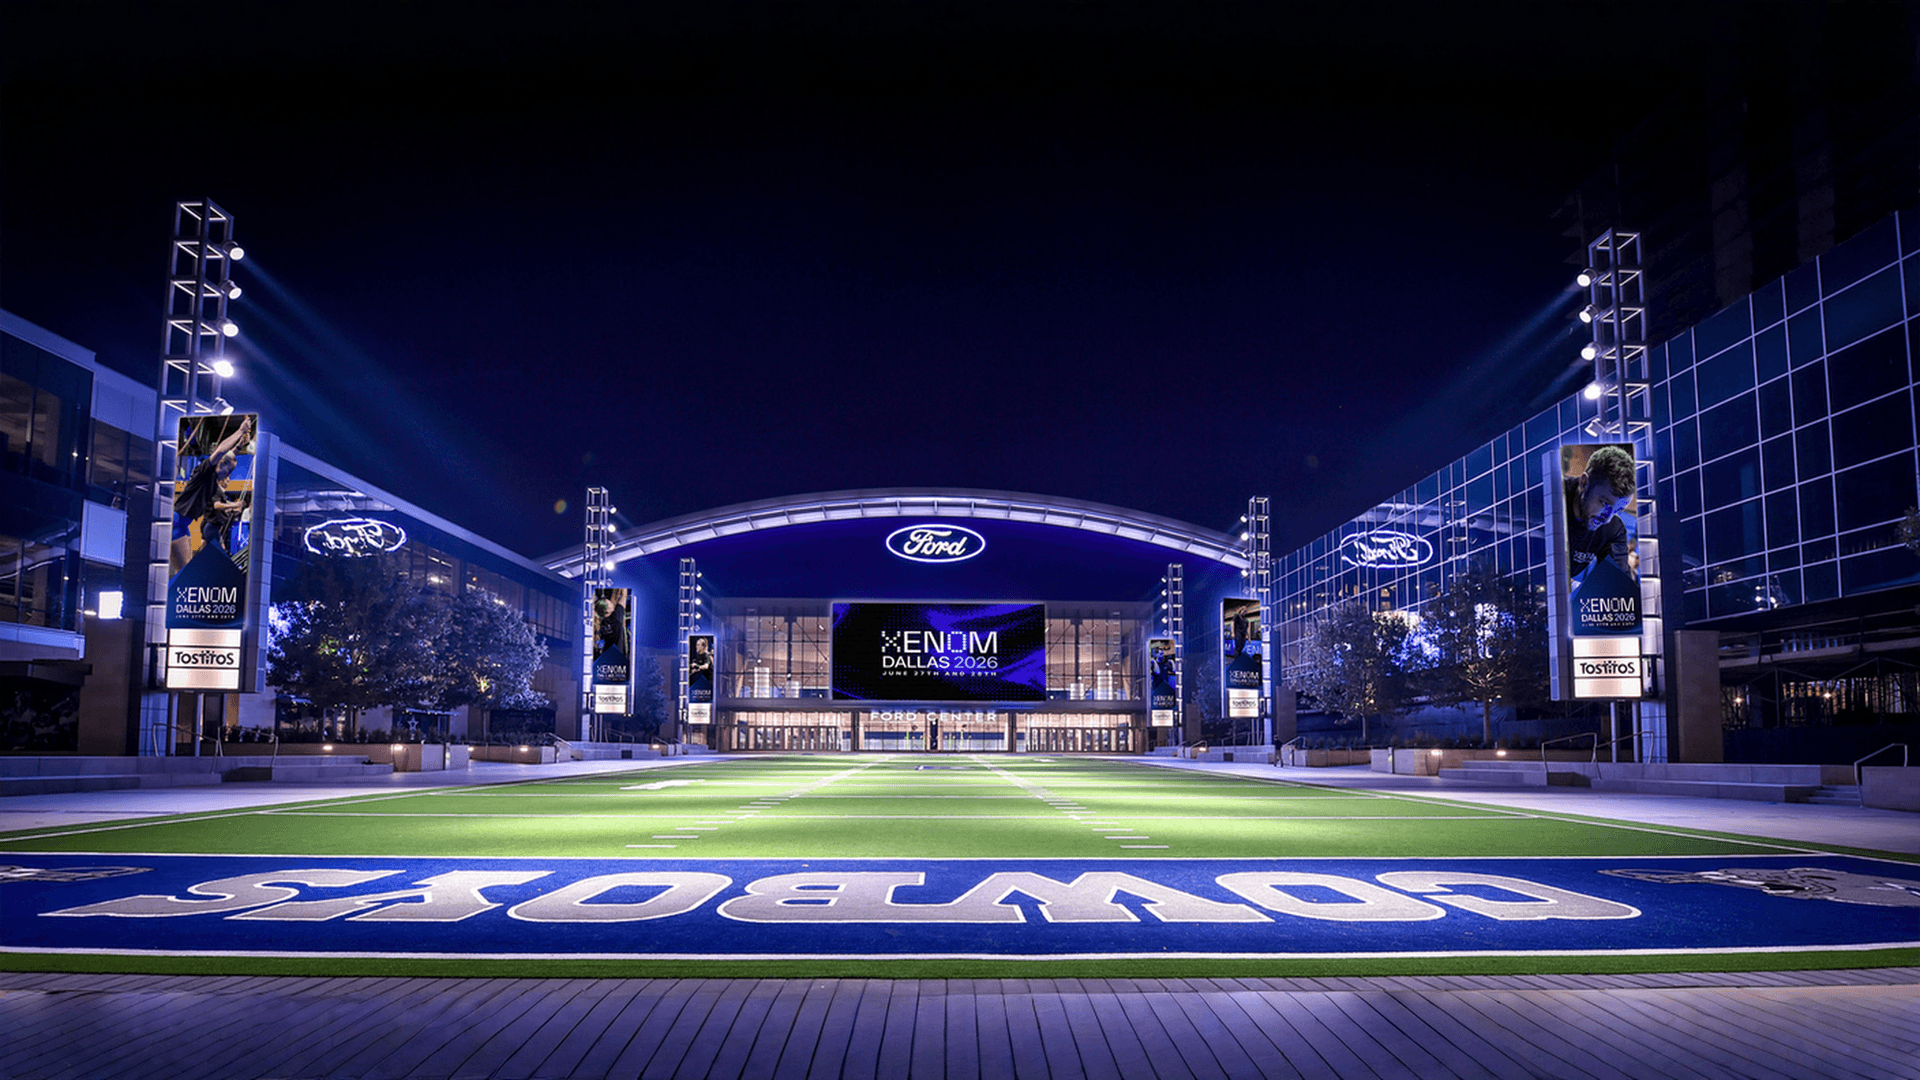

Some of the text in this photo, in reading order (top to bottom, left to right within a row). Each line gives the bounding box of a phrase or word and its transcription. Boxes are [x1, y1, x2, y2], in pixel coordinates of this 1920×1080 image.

[903, 529, 968, 556] Ford
[176, 587, 237, 603] XENOM
[176, 604, 236, 614] DALLAS 2026
[1580, 597, 1635, 613] XENOM
[1581, 612, 1636, 623] DALLAS 2026
[881, 630, 997, 653] XENOM
[882, 656, 998, 669] DALLAS 2026
[870, 711, 997, 722] FORD CENTER
[37, 868, 1642, 922] COWBOYS
